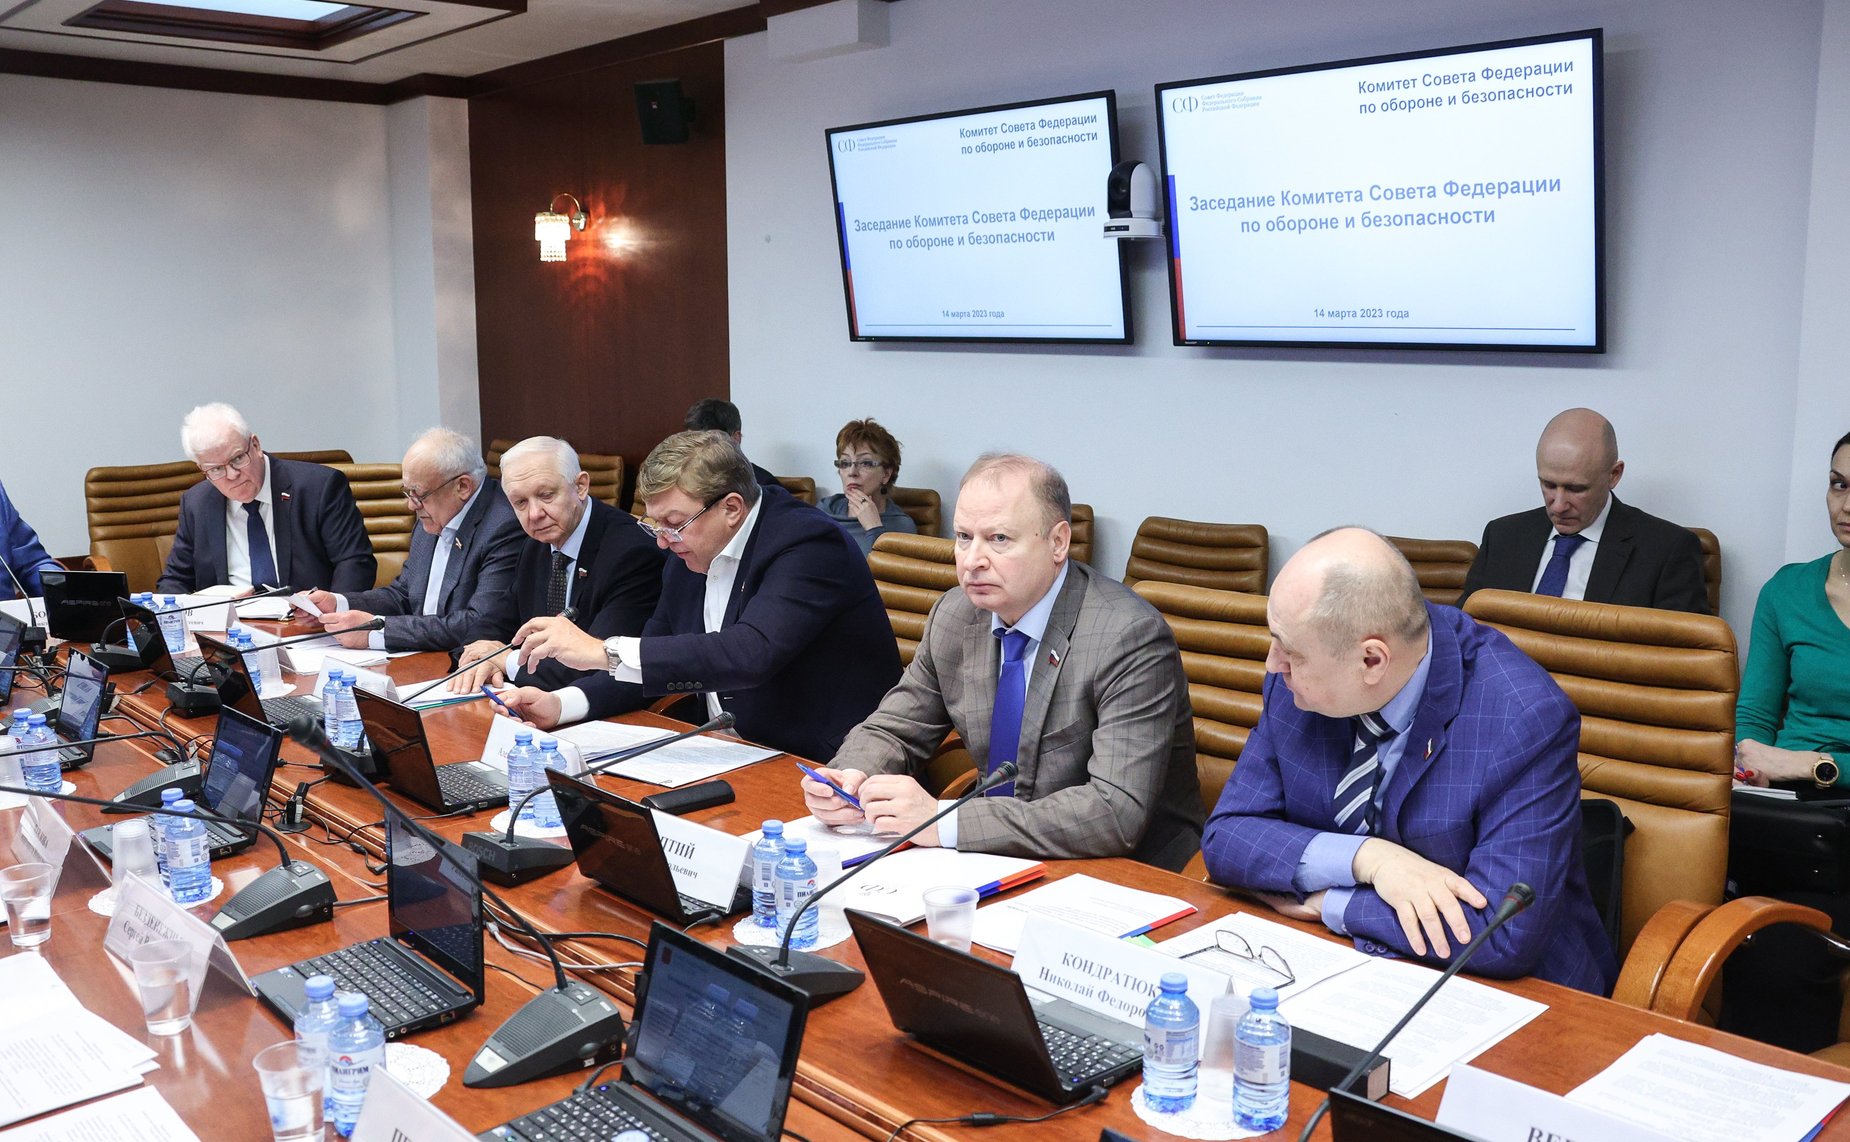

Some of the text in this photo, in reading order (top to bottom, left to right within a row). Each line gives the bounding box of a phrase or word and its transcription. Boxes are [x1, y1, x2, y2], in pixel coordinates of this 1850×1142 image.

[1358, 61, 1574, 94] Комитет Совета Федерации
[1359, 83, 1573, 114] по обороне и безопасности
[959, 114, 1097, 139] Комитет Совета Федерации
[961, 132, 1098, 154] по обороне и безопасности
[1189, 178, 1561, 212] Заседание Комитета Совета Федерации
[854, 206, 1096, 232] Заседание Комитета Совета Федерации
[1241, 209, 1495, 234] по обороне и безопасности
[889, 230, 1055, 250] по обороне и безопасности
[942, 309, 1005, 320] 14 марта 2023 года
[1314, 308, 1410, 320] 14 марта 2023 года
[1039, 966, 1095, 999] Николай
[1061, 951, 1158, 998] КОНДРАТЮК
